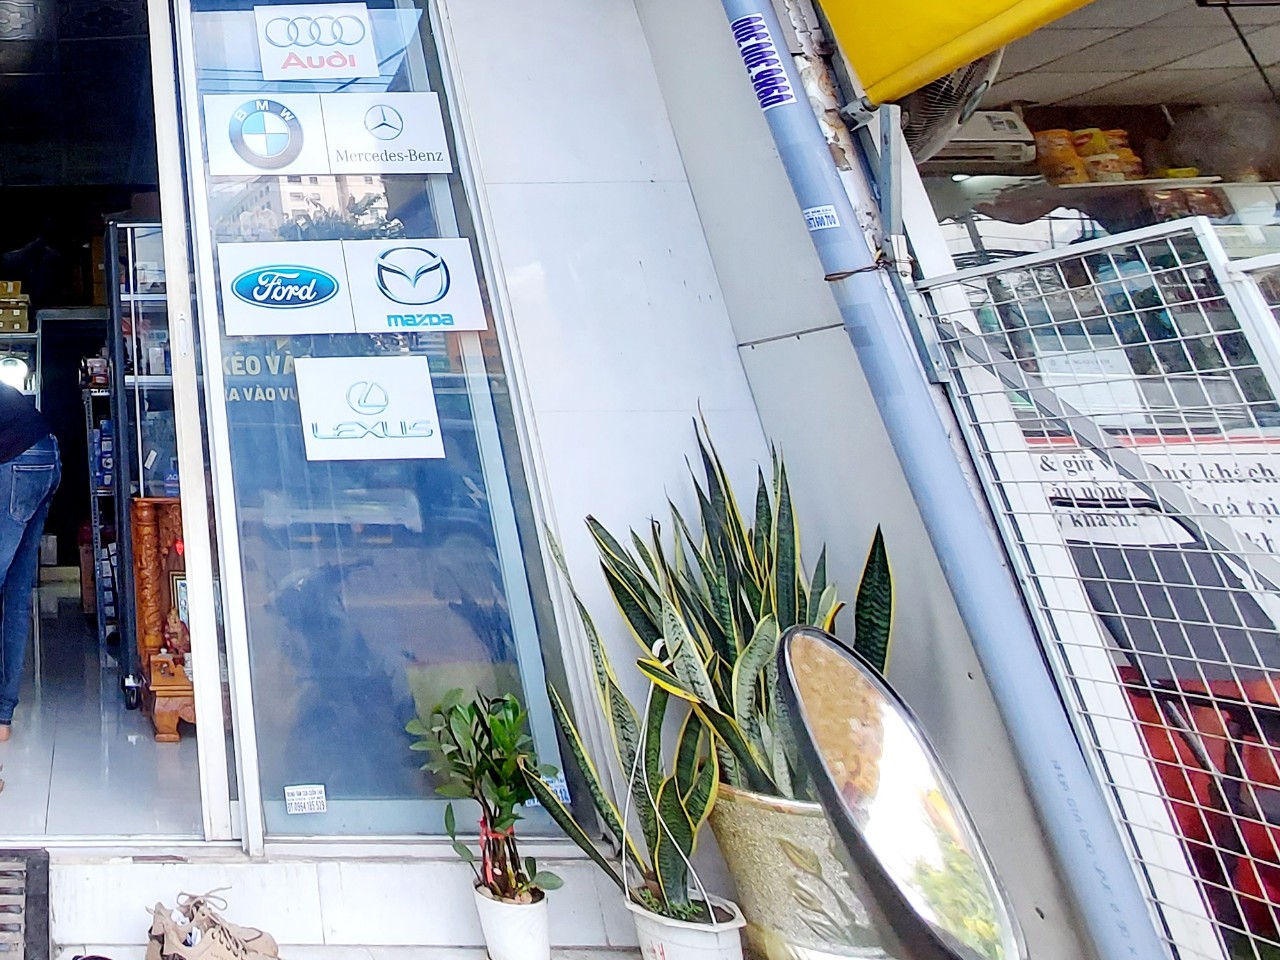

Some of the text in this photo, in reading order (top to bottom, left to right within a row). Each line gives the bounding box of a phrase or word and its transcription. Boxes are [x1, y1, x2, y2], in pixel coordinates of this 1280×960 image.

[281, 51, 357, 70] Audi
[233, 99, 295, 123] BMW
[335, 148, 445, 164] Mercedes-Benz
[251, 271, 319, 302] Ford
[386, 313, 455, 327] mazda
[265, 350, 295, 375] VÀ
[311, 420, 434, 440] LEXUS
